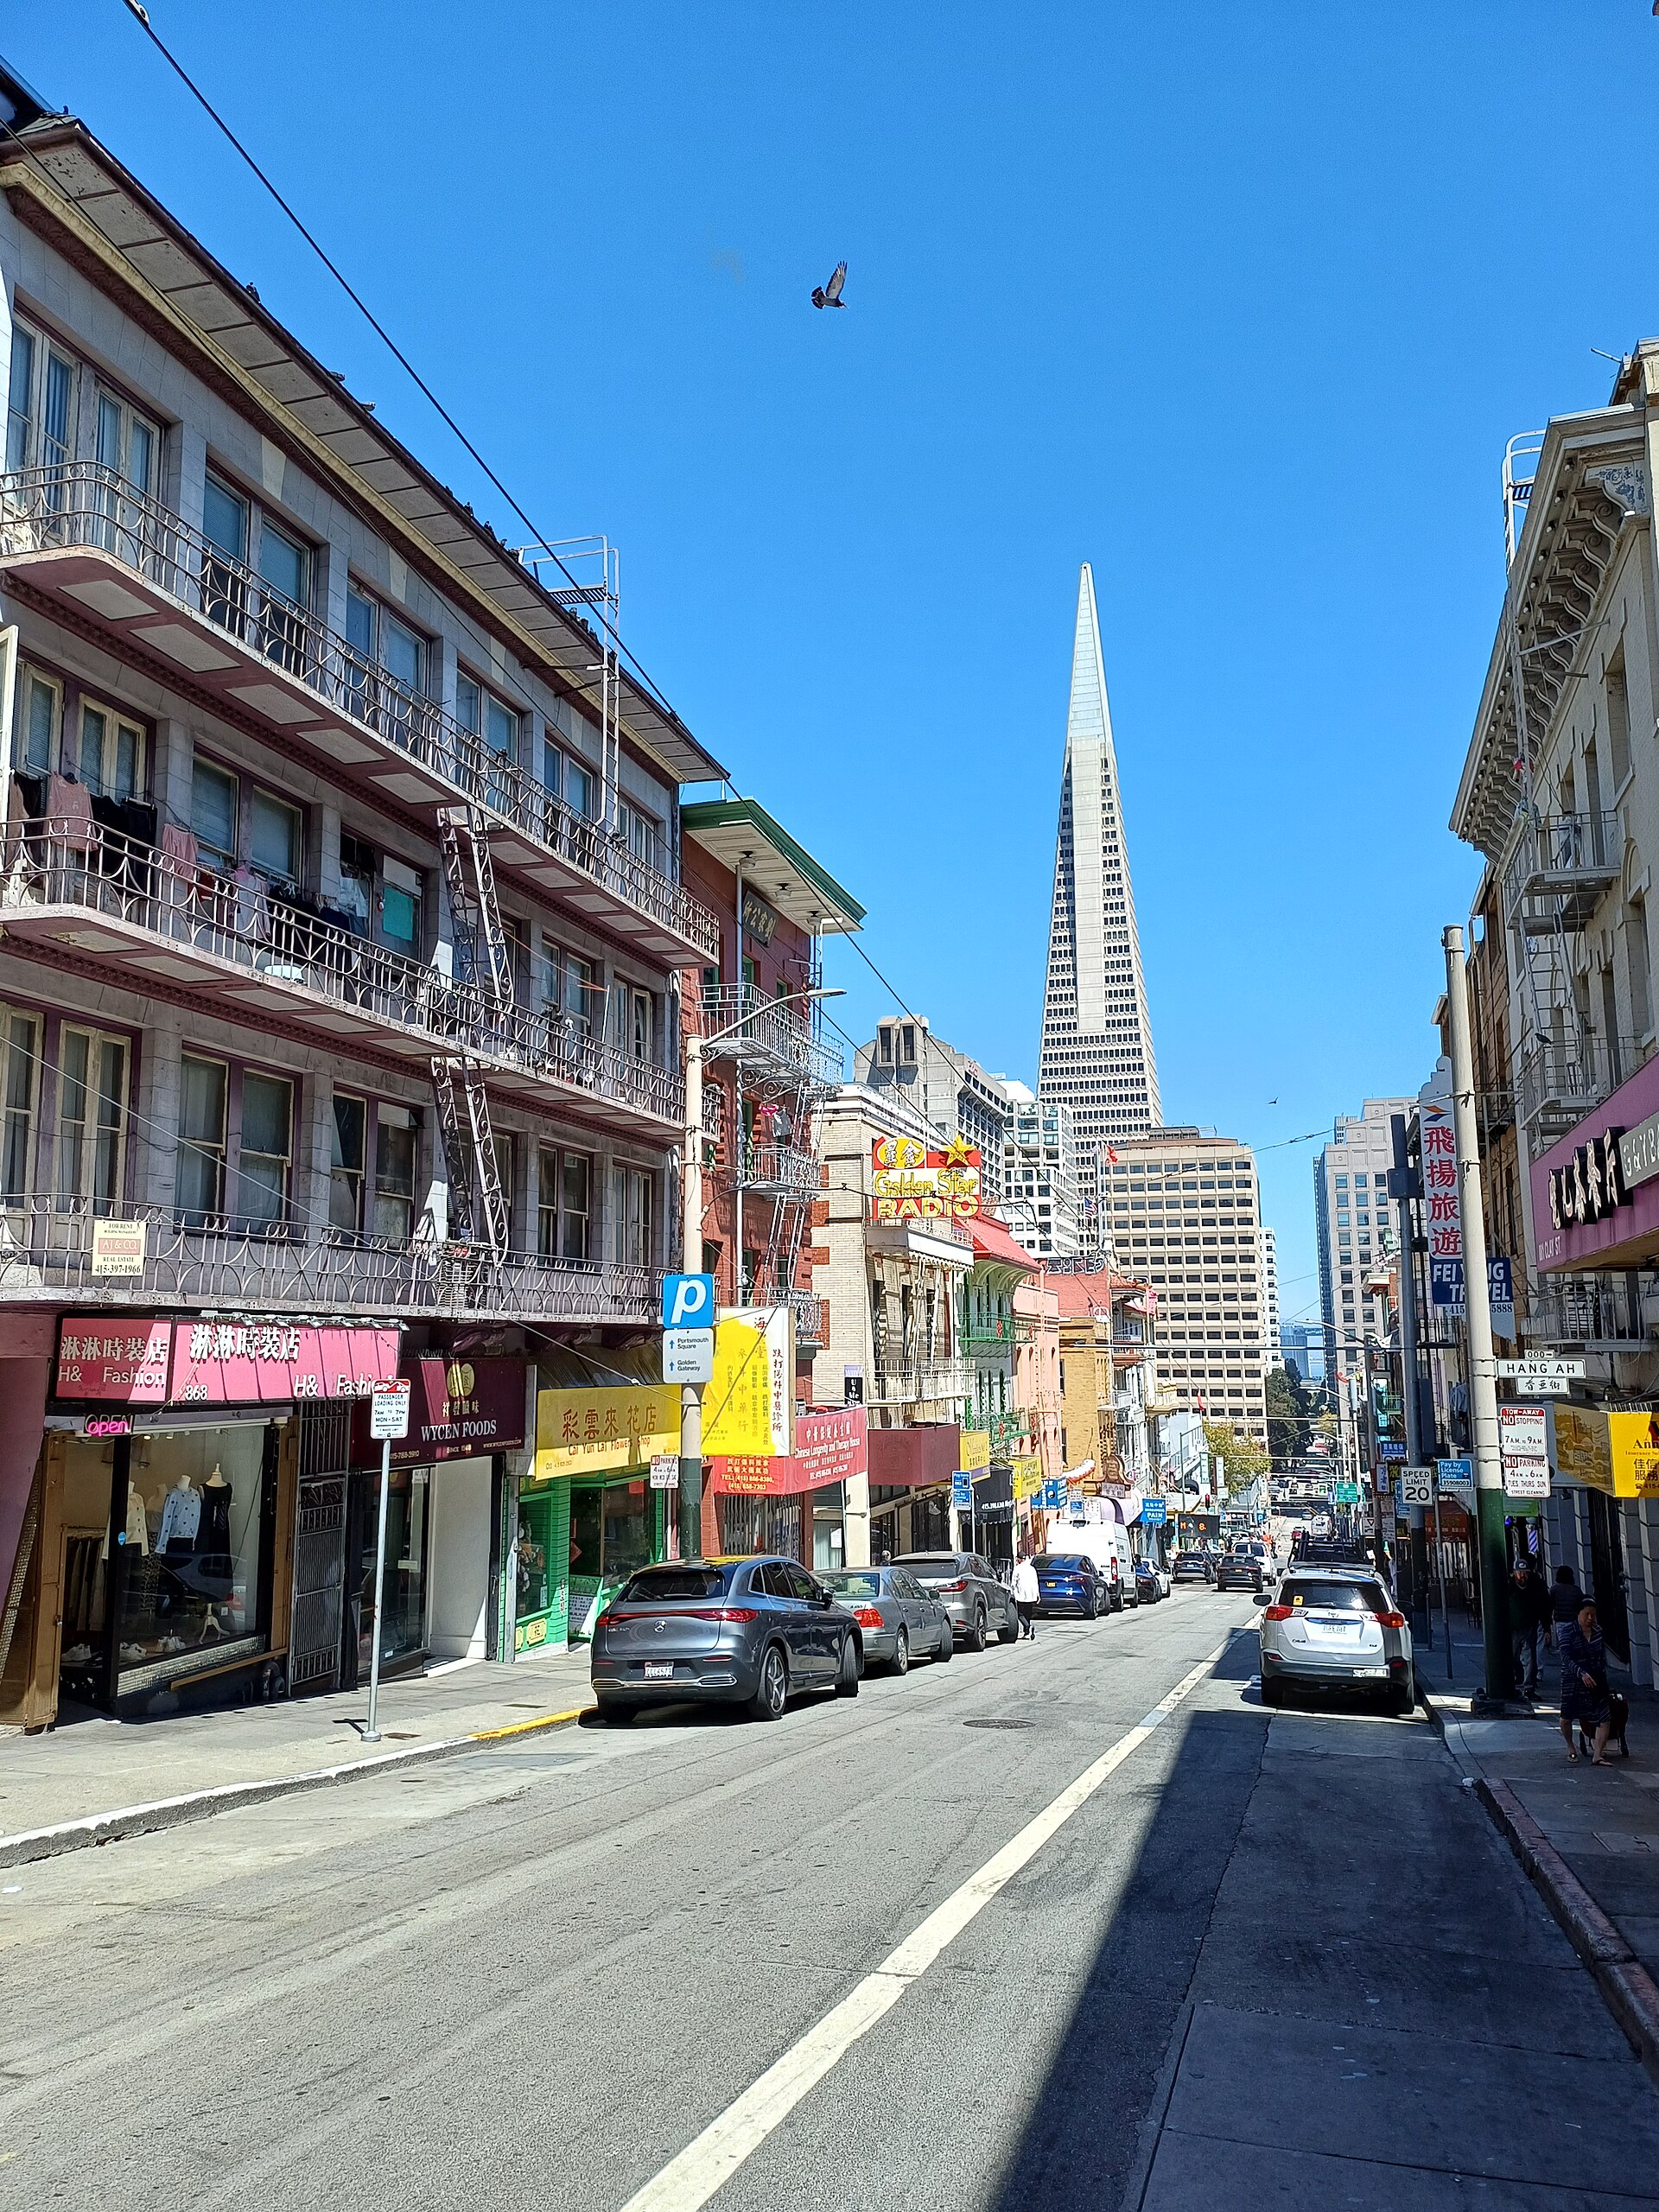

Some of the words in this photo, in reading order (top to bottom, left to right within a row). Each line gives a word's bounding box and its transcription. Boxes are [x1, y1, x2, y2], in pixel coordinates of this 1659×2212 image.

[874, 1169, 934, 1197] Golden
[937, 1167, 978, 1195] Star
[1424, 1125, 1462, 1255] 飛揚旅遊
[877, 1195, 979, 1218] RADIO
[102, 1239, 113, 1251] AJ
[1433, 1263, 1457, 1282] FEI
[189, 1324, 302, 1361] 淋淋時裝店
[677, 1336, 709, 1344] Portsmouth
[60, 1336, 168, 1365] 淋淋時裝店
[58, 1364, 82, 1382] H&
[103, 1366, 166, 1385] Fashion
[1507, 1363, 1548, 1374] HANG
[1555, 1363, 1575, 1374] AH
[185, 1384, 208, 1401] 868
[293, 1374, 319, 1398] H&
[1503, 1415, 1515, 1425] NO
[1516, 1417, 1543, 1426] STOPPING
[421, 1423, 461, 1442] WYCEN
[461, 1420, 498, 1438] FOODS
[446, 1446, 460, 1454] SINCE
[569, 1443, 579, 1456] Cai
[582, 1441, 595, 1455] Yun
[597, 1440, 607, 1453] Lai
[610, 1438, 633, 1452] Flowers
[637, 1435, 651, 1449] Shop
[652, 1455, 659, 1465] NO
[1505, 1456, 1517, 1467] NO
[1519, 1459, 1546, 1468] PARKING
[1634, 1470, 1658, 1482] 服務
[1405, 1486, 1430, 1502] 20
